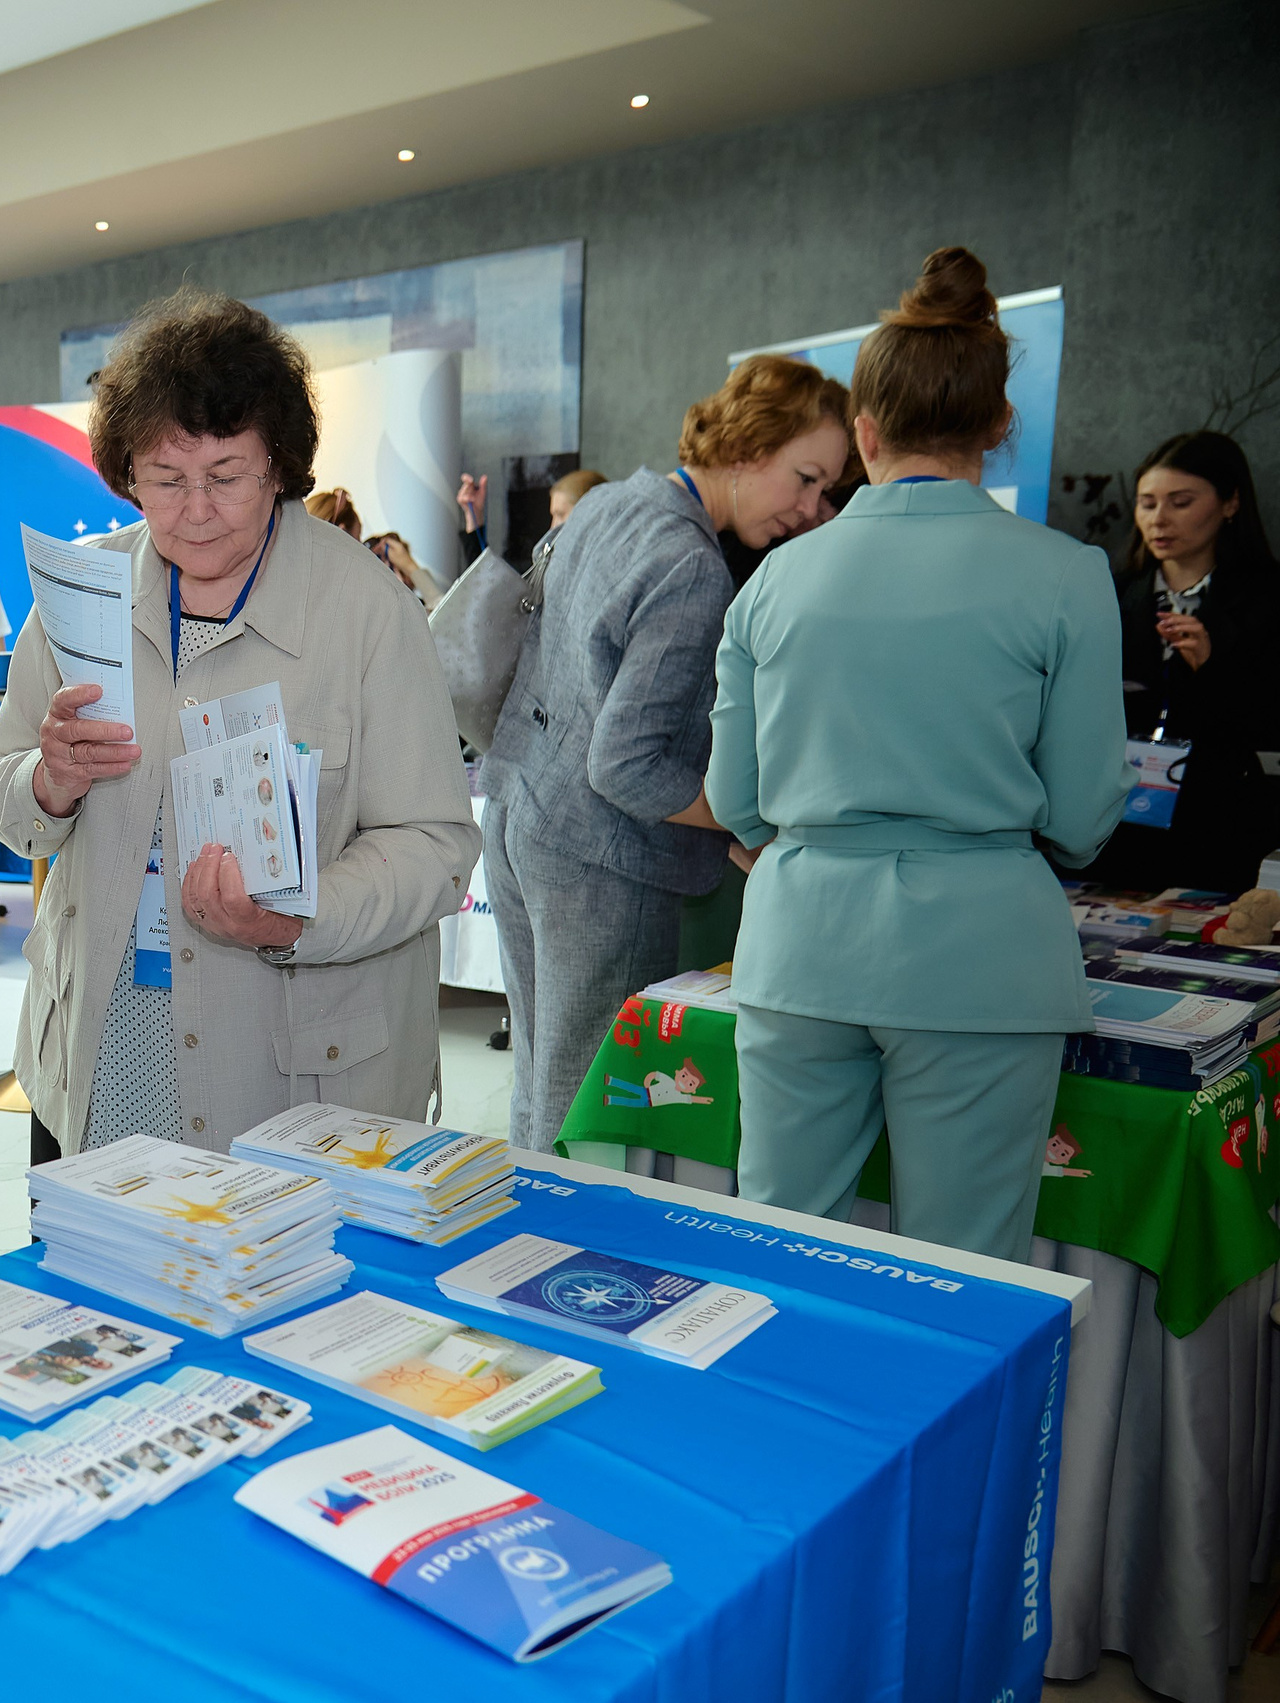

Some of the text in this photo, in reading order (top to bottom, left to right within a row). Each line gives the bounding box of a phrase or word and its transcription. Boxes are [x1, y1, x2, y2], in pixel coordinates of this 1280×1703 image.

[613, 998, 651, 1048] ЙЗ
[417, 1136, 488, 1176] НЕЙРОМУЛЬТИВИТ
[224, 1177, 306, 1213] НЕЙРОМУЛЬТИВИТ
[663, 1211, 965, 1293] BAUSCH Health
[665, 1292, 746, 1341] СОНАПАКС
[524, 1371, 575, 1401] Флуоксетин
[1039, 1336, 1064, 1463] Health
[359, 1464, 439, 1491] МЕДИЦИНА
[376, 1471, 457, 1502] БОЛИ 2025
[417, 1515, 555, 1584] ПРОГРАММА
